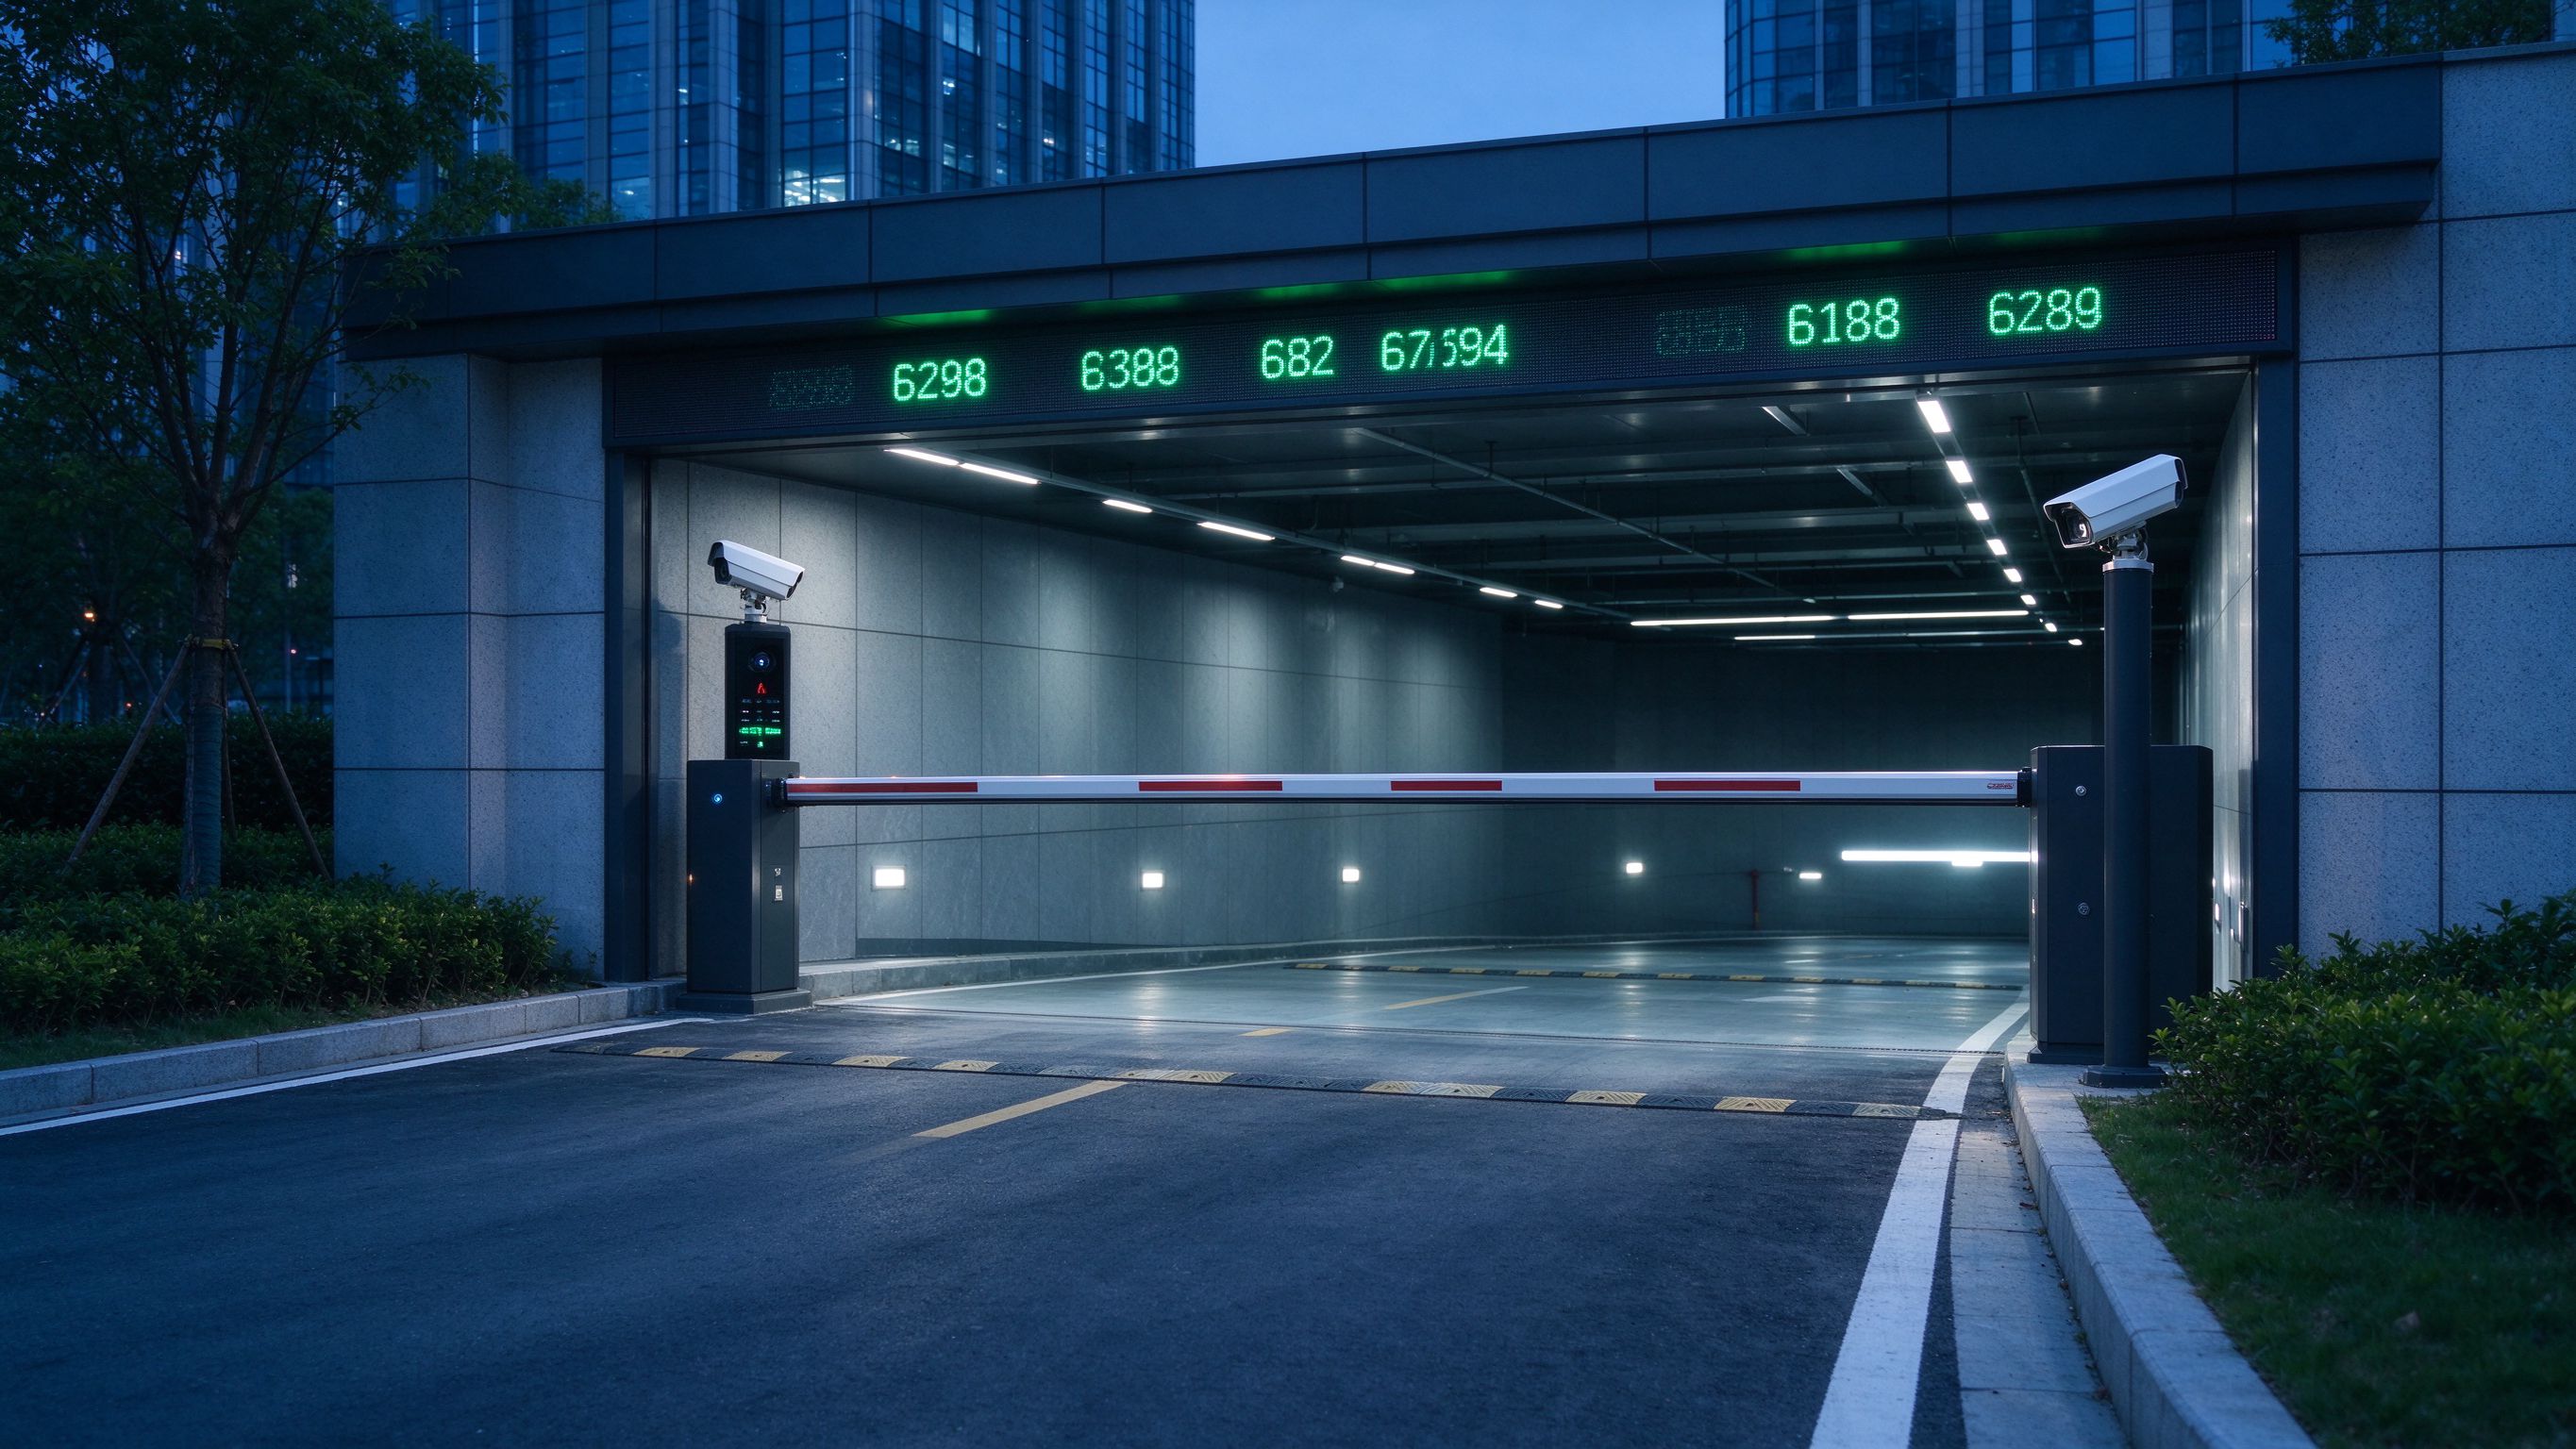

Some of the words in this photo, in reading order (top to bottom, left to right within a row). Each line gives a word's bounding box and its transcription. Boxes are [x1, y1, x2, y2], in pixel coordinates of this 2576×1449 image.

[893, 358, 987, 402] 6298
[1081, 346, 1179, 391] 6388
[1261, 335, 1334, 379] 682
[1788, 297, 1900, 347] 6188
[1988, 287, 2101, 336] 6289
